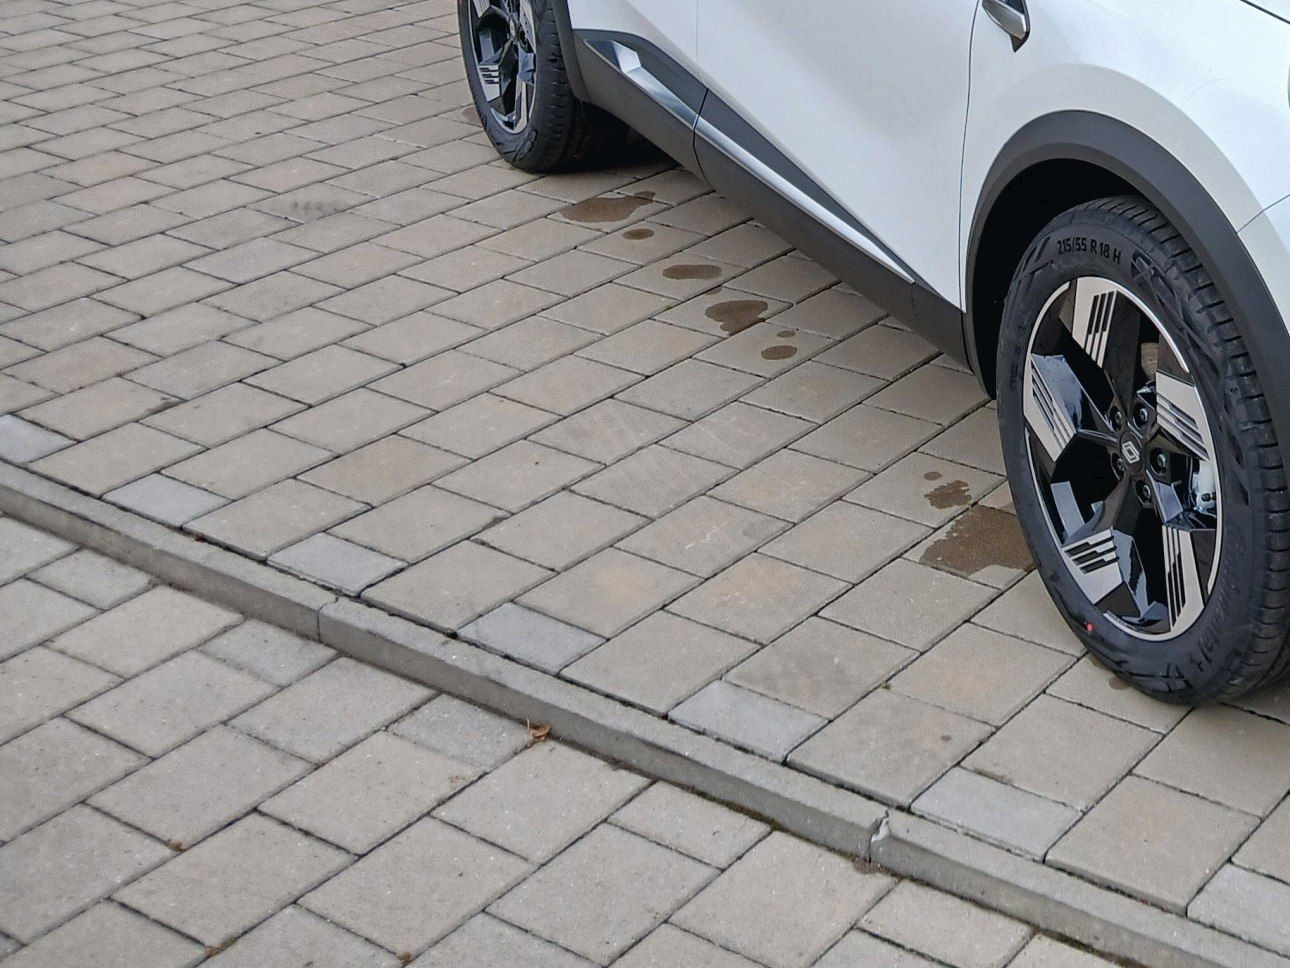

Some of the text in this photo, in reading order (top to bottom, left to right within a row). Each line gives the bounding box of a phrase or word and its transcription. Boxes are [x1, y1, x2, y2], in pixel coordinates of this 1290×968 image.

[1056, 236, 1122, 265] 215/55 R 18 H
